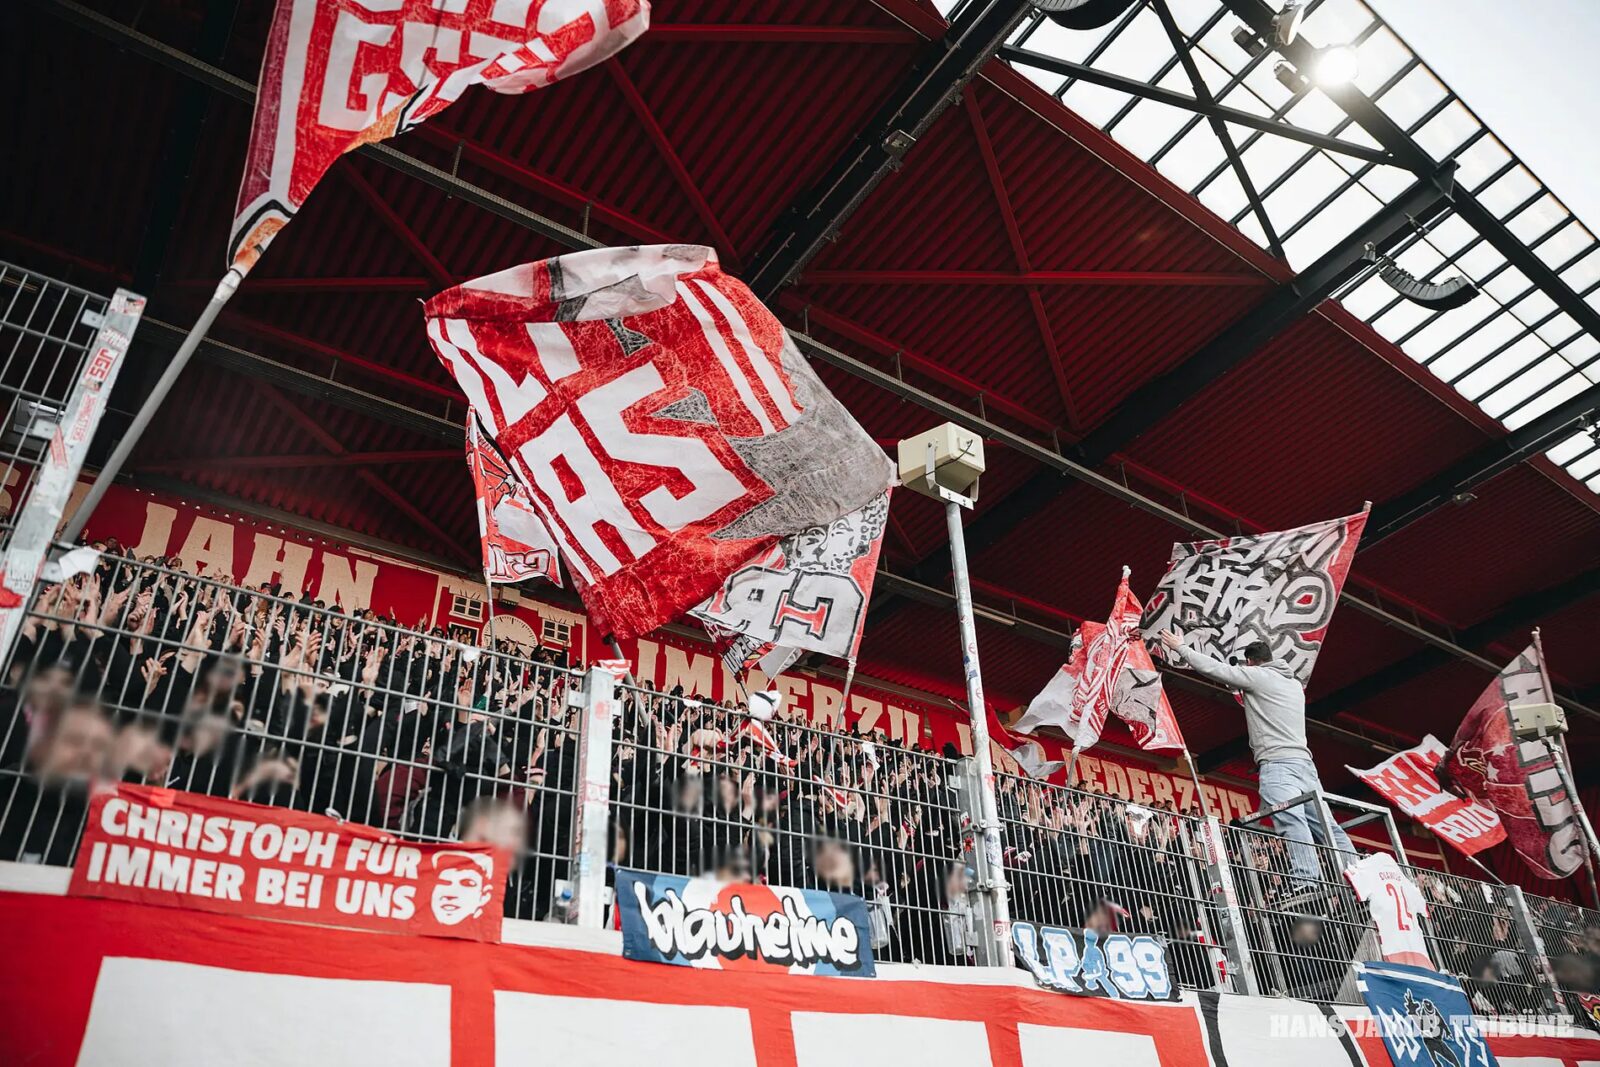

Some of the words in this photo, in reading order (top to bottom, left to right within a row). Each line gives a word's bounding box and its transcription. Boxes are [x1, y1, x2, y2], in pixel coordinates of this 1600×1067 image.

[133, 501, 379, 614] JAHN
[101, 799, 339, 869] CHRISTOPH
[345, 836, 421, 880] FÜR
[87, 842, 245, 901] IMMER
[256, 869, 324, 909] BEI
[335, 878, 417, 921] UNS
[1102, 934, 1173, 1000] 99
